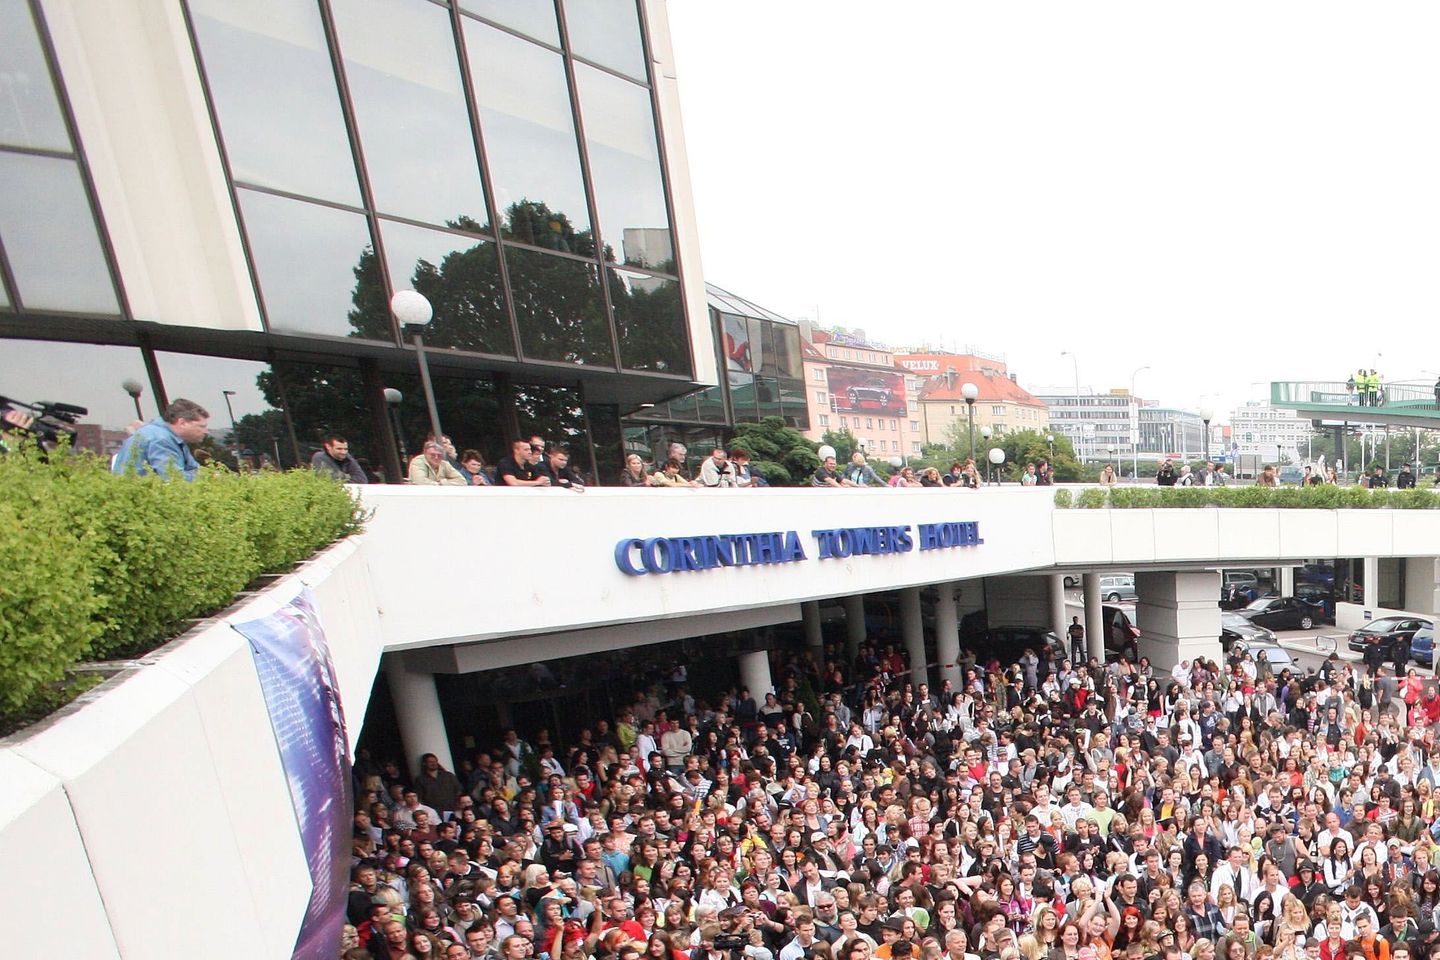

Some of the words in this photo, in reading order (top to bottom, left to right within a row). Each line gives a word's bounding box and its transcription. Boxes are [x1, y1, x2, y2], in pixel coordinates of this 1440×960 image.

[902, 360, 940, 370] VELUX
[614, 530, 808, 577] CORINTHIA
[811, 524, 914, 560] TOWERS
[917, 520, 984, 551] HOTEL
